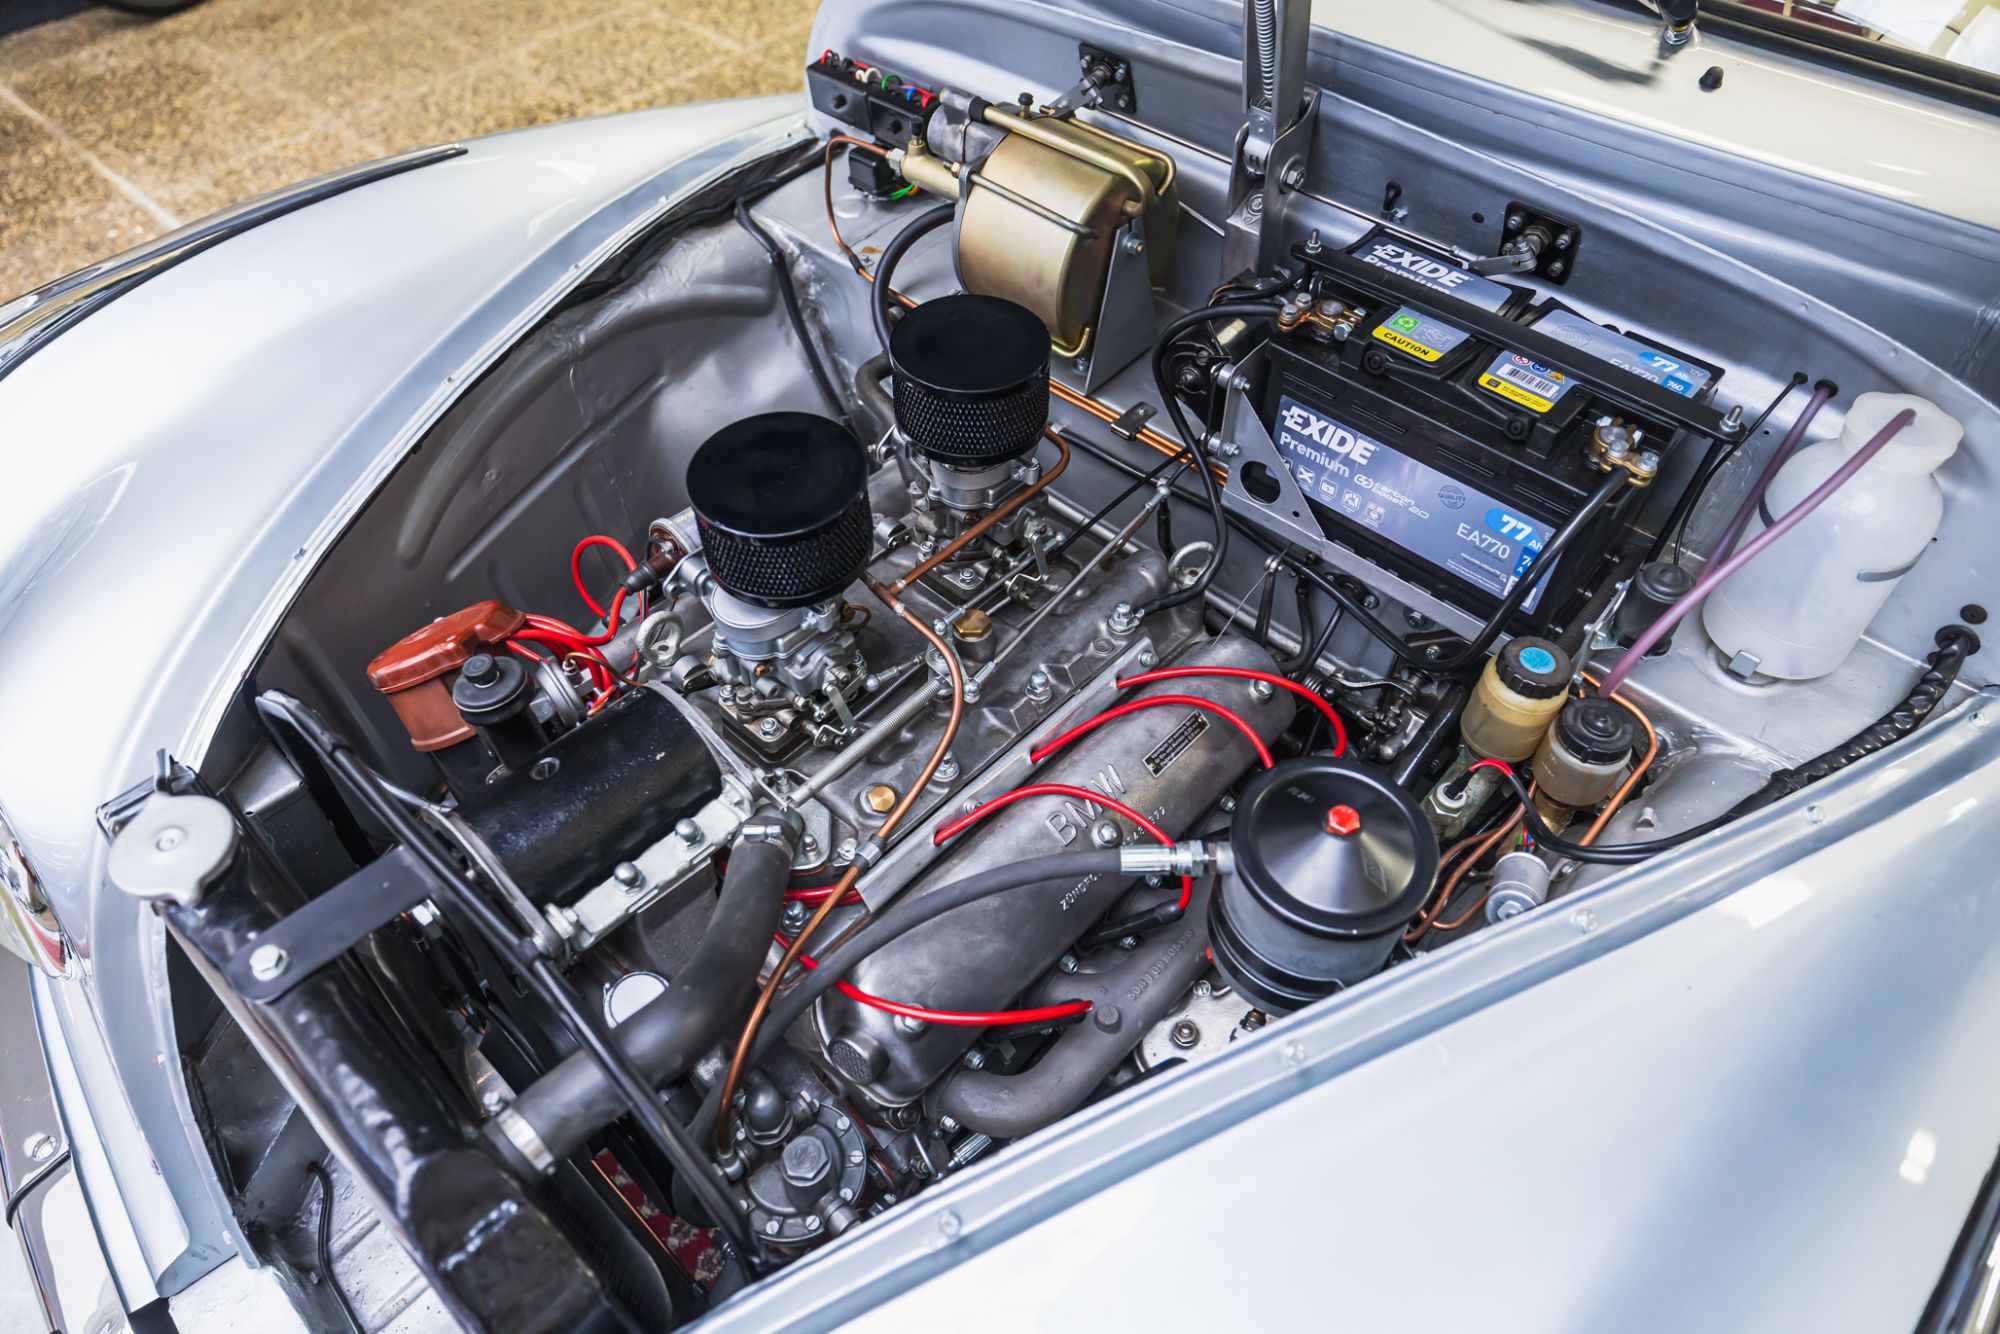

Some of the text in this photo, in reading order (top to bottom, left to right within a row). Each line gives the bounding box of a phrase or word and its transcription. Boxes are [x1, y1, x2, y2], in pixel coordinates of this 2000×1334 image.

[1373, 244, 1470, 287] EXIDE
[1383, 332, 1430, 356] CAUTION
[1651, 356, 1679, 372] 77
[1667, 380, 1684, 391] 760
[1282, 405, 1377, 466] EXIDE
[1279, 432, 1350, 478] Premium
[1456, 522, 1510, 559] EA770
[1501, 514, 1533, 541] 77
[1044, 763, 1126, 846] BMW
